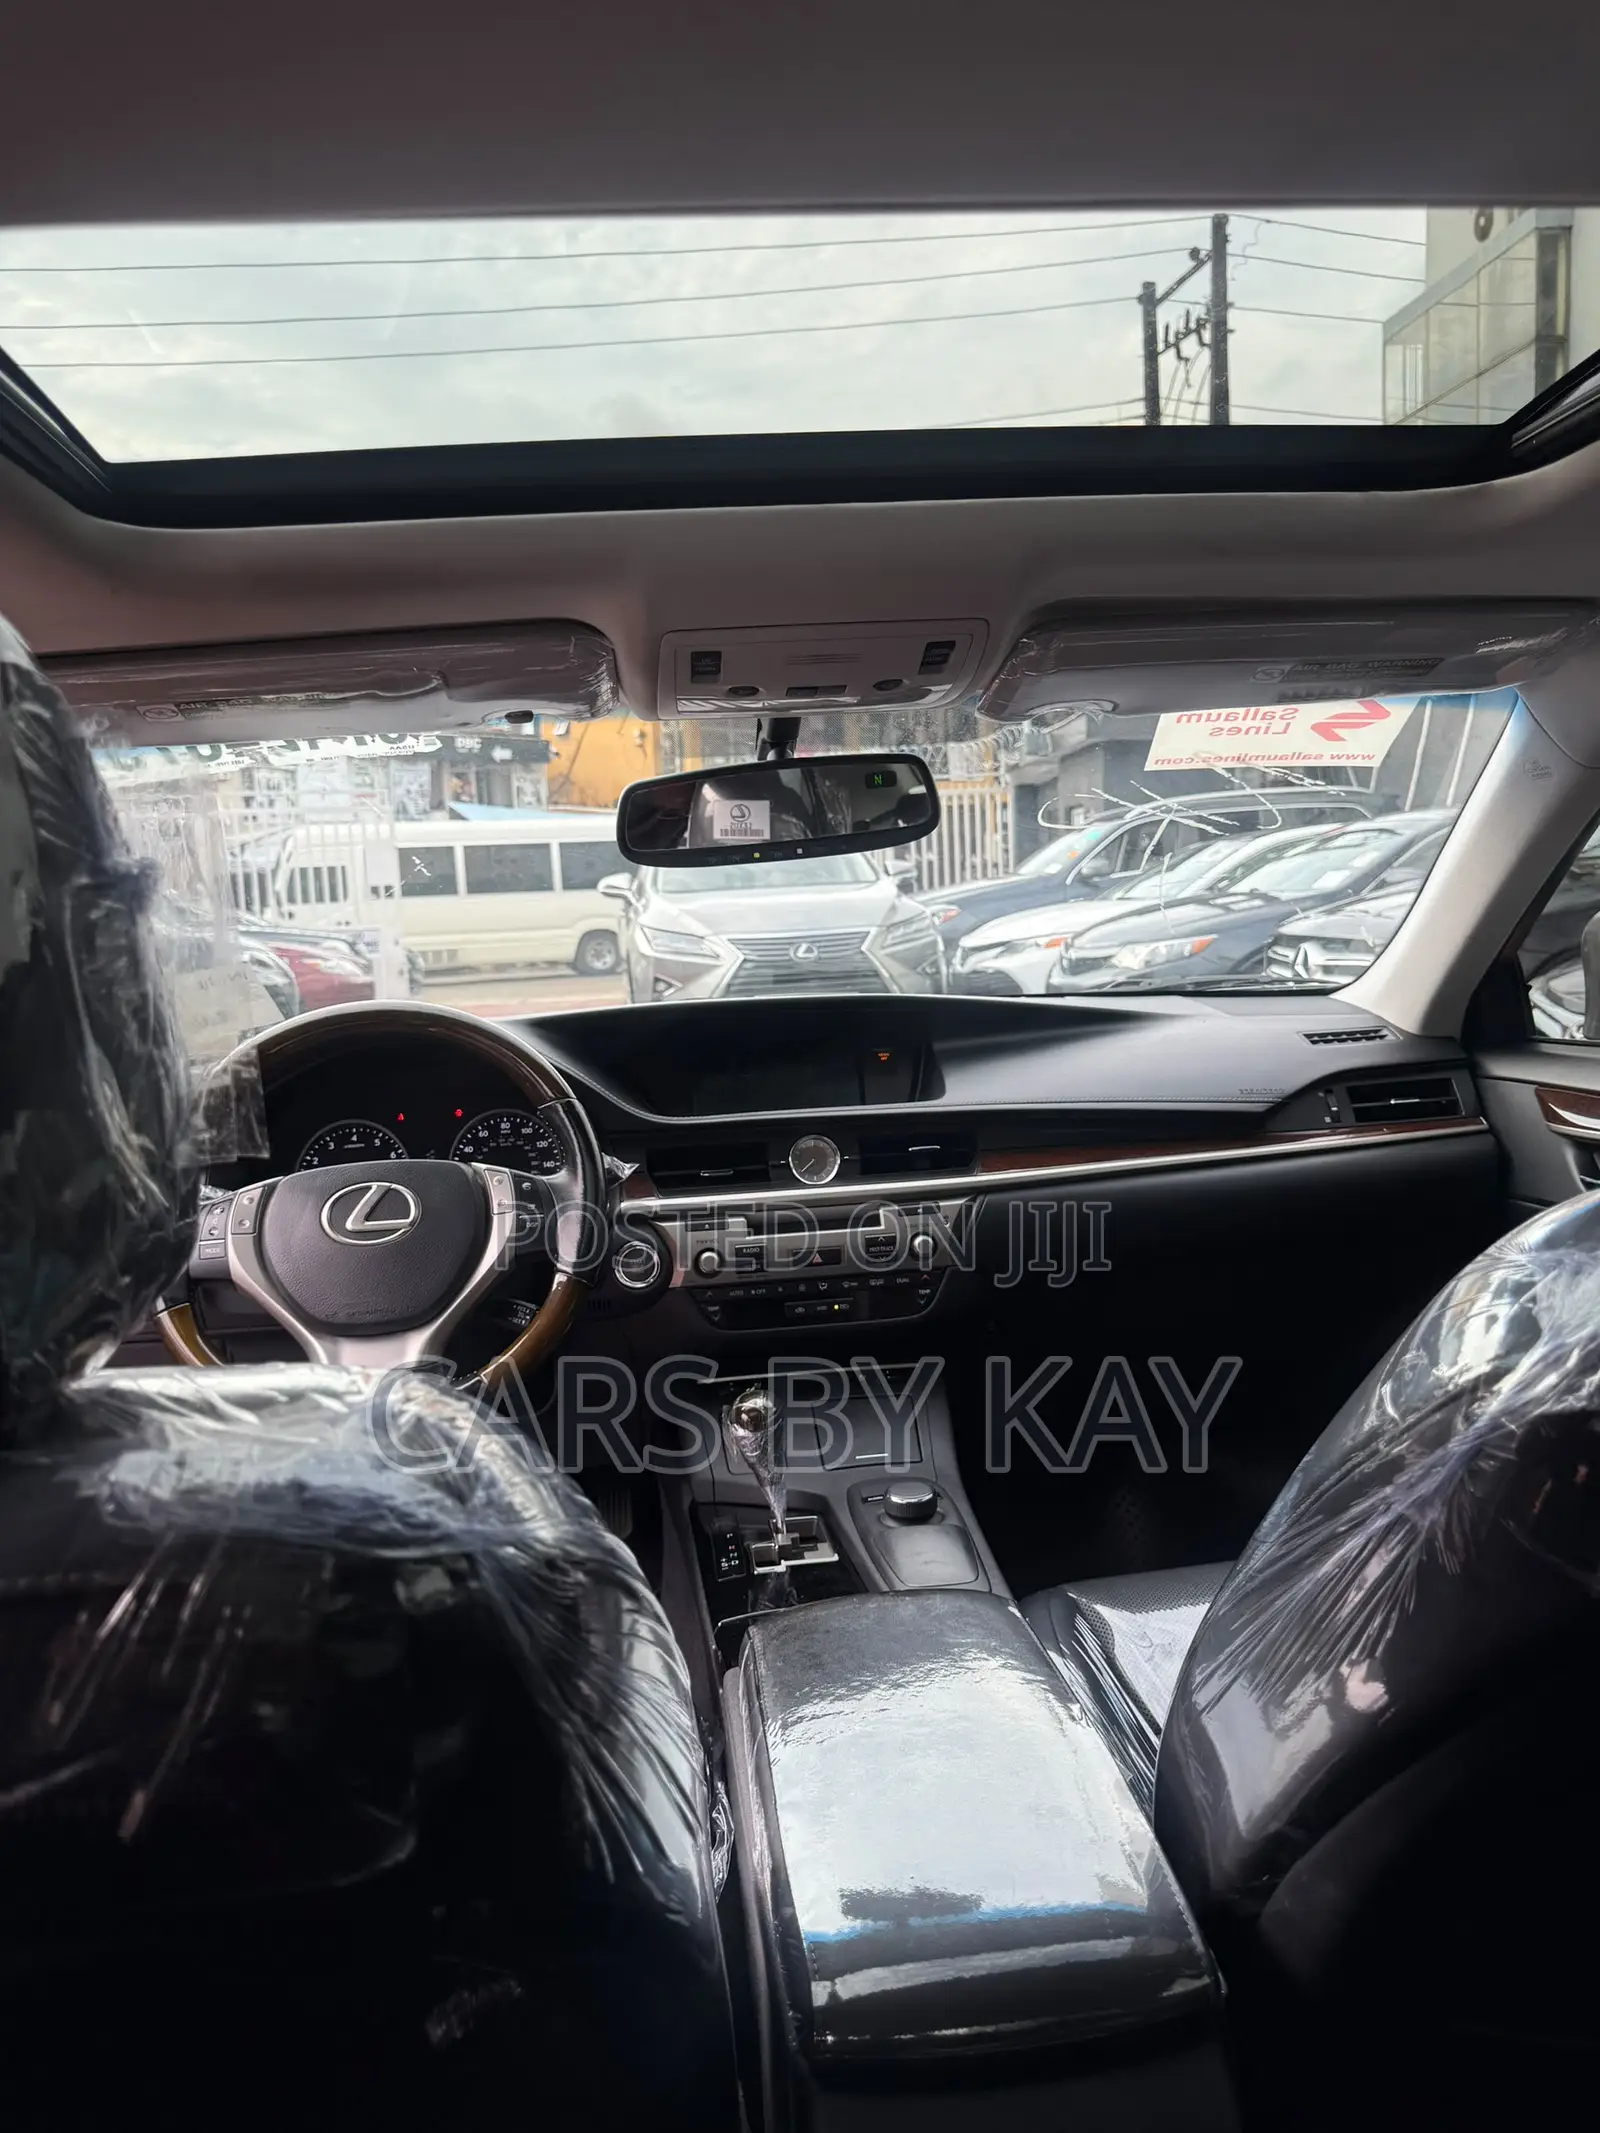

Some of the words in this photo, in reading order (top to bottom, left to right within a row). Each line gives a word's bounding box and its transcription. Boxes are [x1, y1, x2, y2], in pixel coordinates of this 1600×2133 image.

[874, 774, 882, 785] N
[500, 1122, 511, 1130] 80
[478, 1130, 489, 1138] 60
[328, 1142, 335, 1150] 3
[374, 1138, 381, 1146] 5
[463, 1145, 474, 1153] 40
[390, 1151, 397, 1159] 6
[312, 1157, 319, 1165] 2
